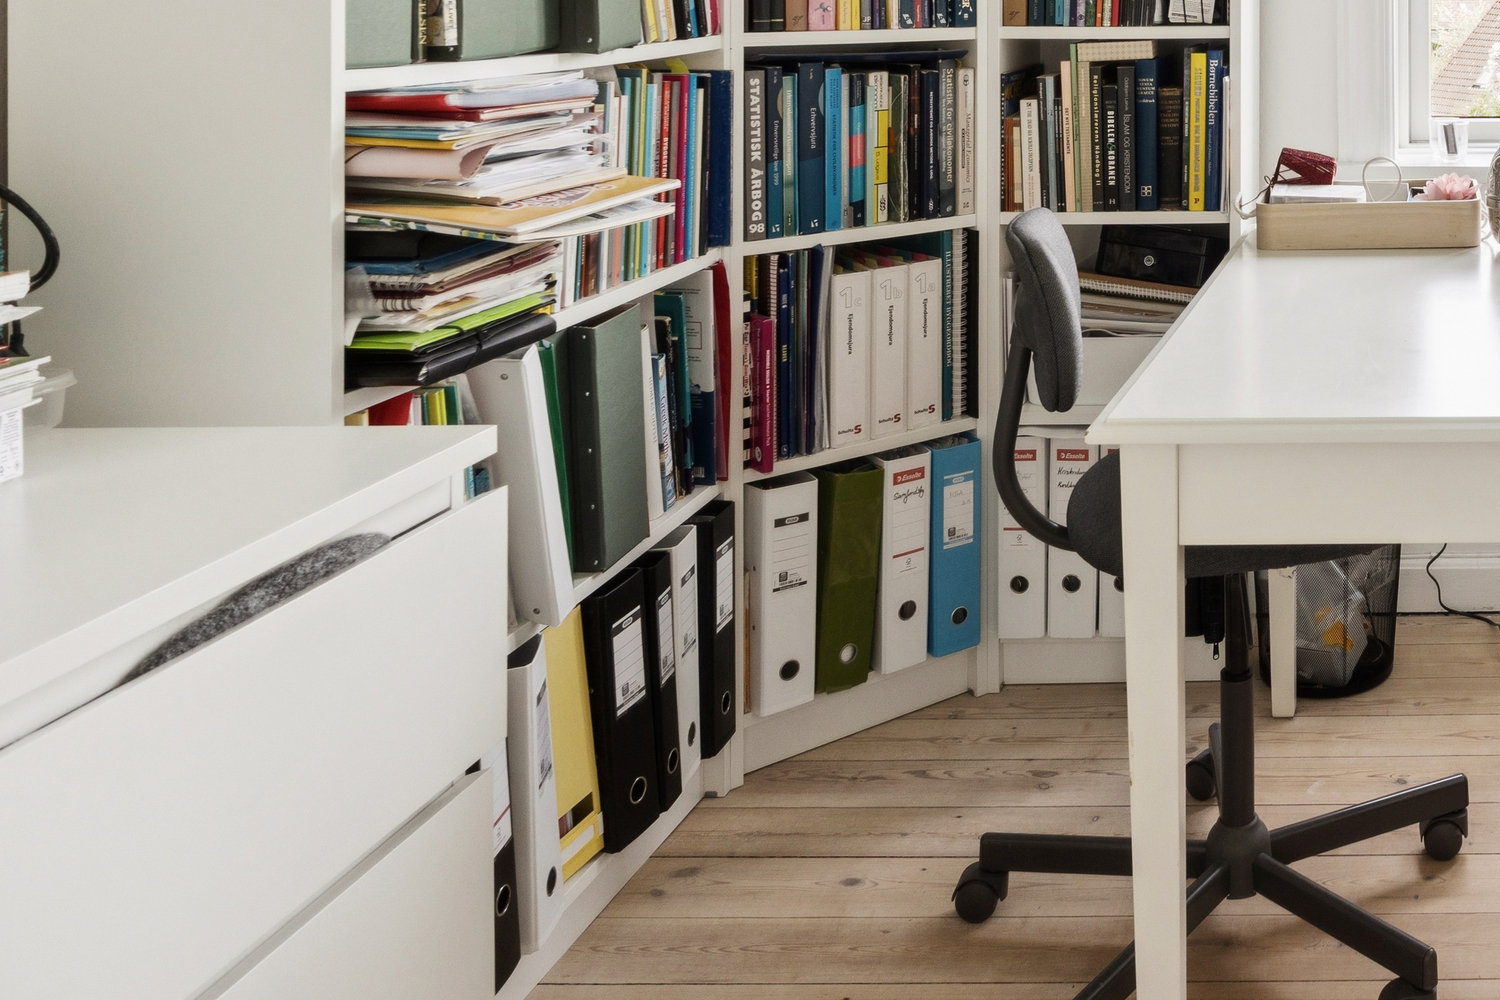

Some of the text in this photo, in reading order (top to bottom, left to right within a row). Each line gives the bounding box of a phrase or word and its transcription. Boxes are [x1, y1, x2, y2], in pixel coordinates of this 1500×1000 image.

[1208, 58, 1218, 125] Børnebibelen
[661, 137, 669, 178] BYGGESTEN
[749, 77, 763, 221] STATISTISK ÅRBOG
[809, 107, 817, 149] Erhvervsjura
[946, 68, 954, 183] Statistik for civiløkonomer
[1106, 110, 1116, 186] BIBELEN KORANEN
[1123, 114, 1132, 194] ISLAM OG KRISTENDOM
[748, 223, 765, 233] 98
[659, 396, 670, 459] Greek Myths
[902, 471, 923, 481] Esselte
